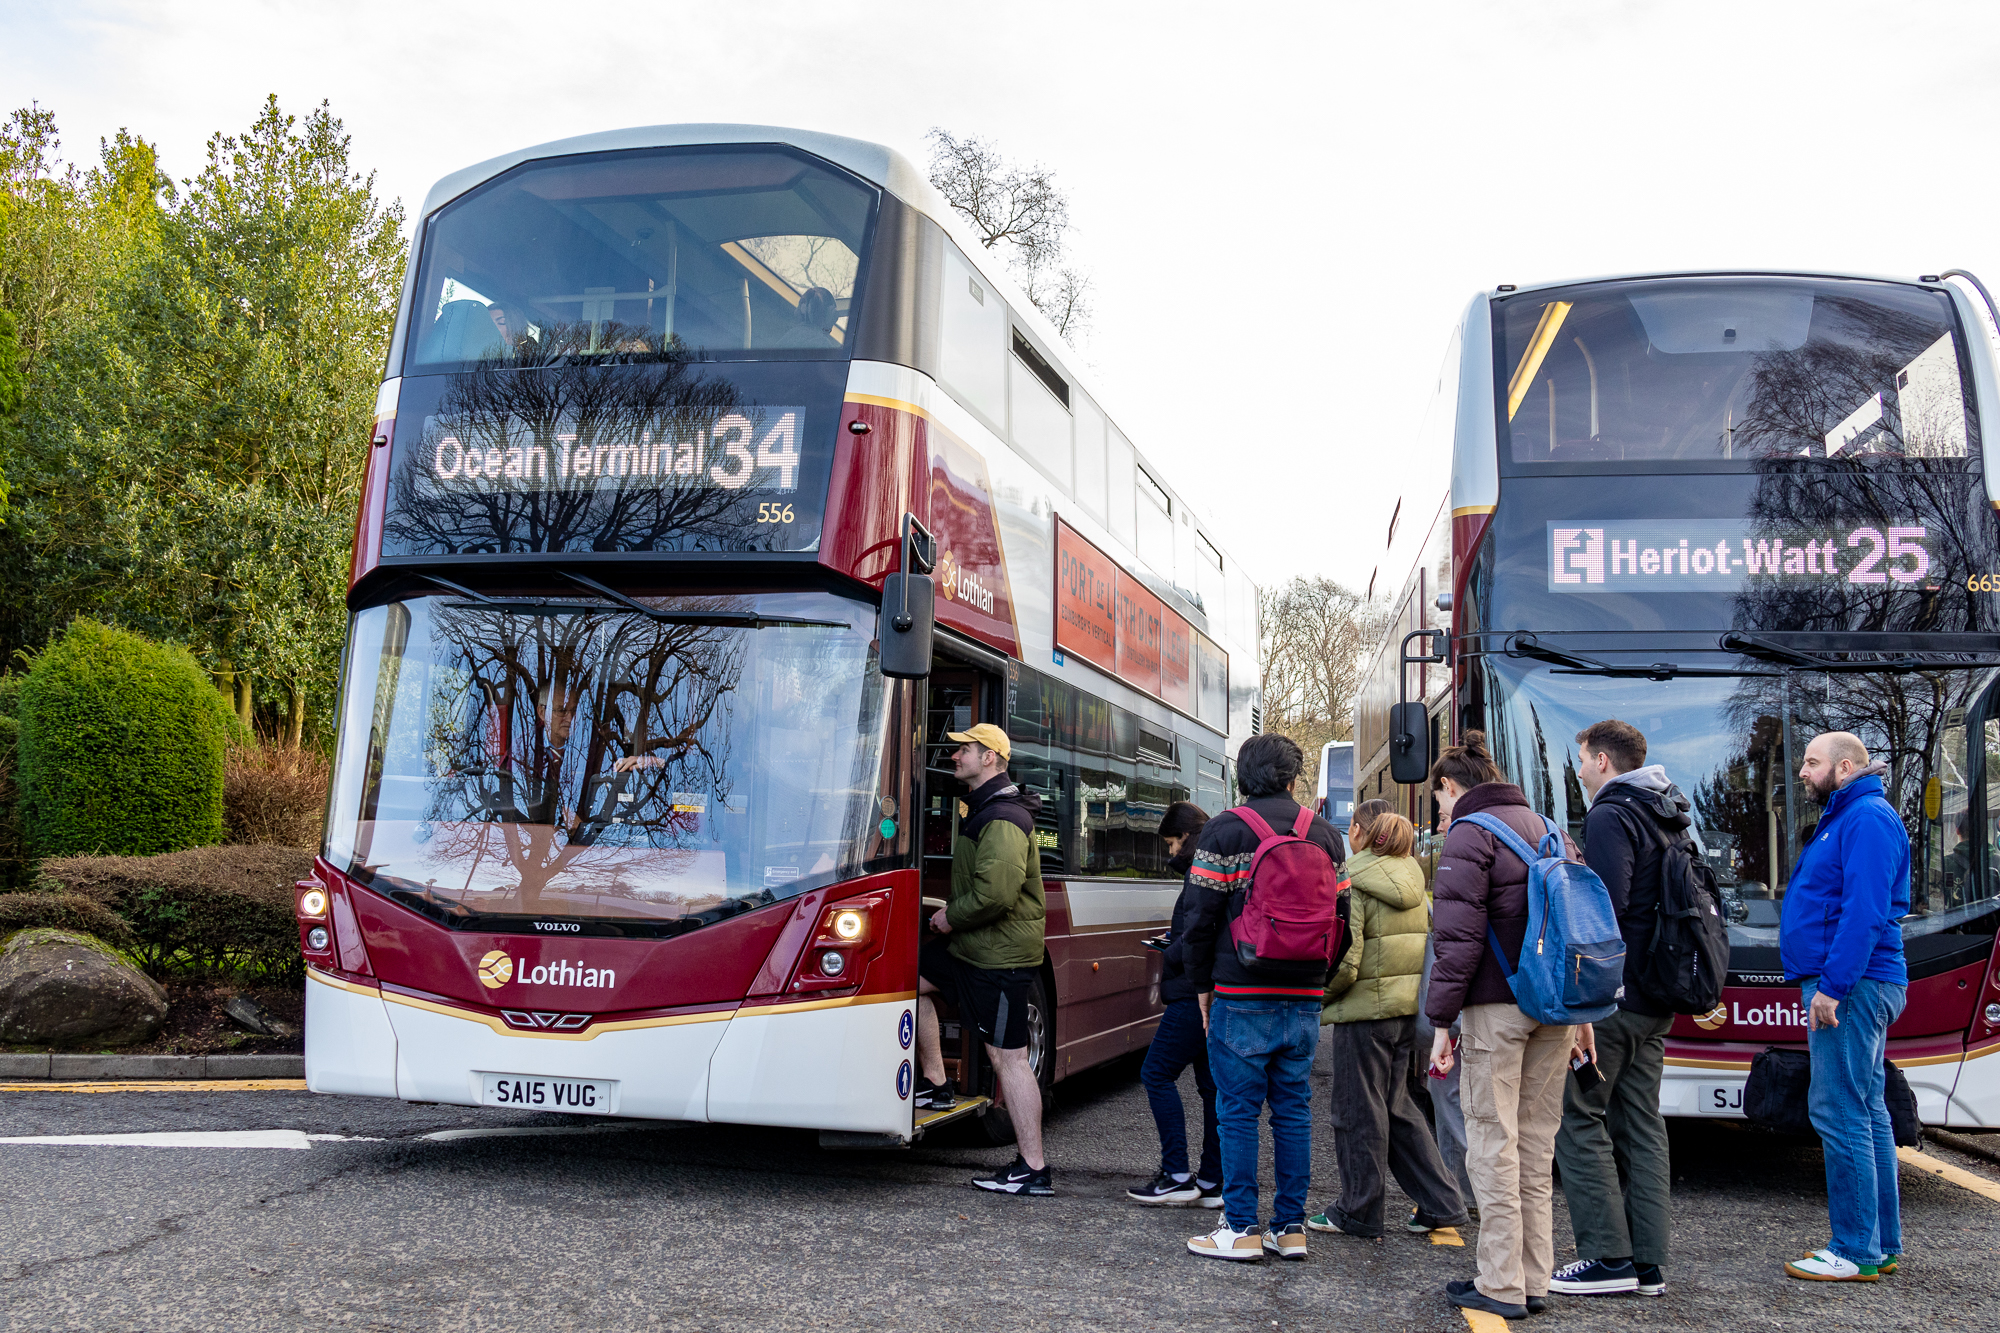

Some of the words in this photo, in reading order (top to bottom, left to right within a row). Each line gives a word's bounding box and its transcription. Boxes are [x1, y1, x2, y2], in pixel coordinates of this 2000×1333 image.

[435, 437, 547, 479] Ocean
[557, 431, 705, 477] Terminal
[710, 413, 798, 489] 34
[757, 503, 795, 524] 556
[1611, 539, 1838, 575] Heriot-Watt
[1847, 527, 1930, 583] 25
[957, 564, 994, 615] Lothian
[1062, 549, 1094, 607] PORT
[1096, 580, 1104, 604] OF
[1107, 582, 1135, 637] LEITH
[1967, 573, 2000, 592] 665
[1009, 661, 1018, 682] 556
[533, 921, 581, 932] VOLVO
[517, 957, 616, 989] Lothian
[1738, 974, 1786, 984] VOLVO
[1733, 1001, 1808, 1027] Lothia
[497, 1080, 546, 1105] SA15
[552, 1083, 596, 1107] VUG
[1713, 1088, 1742, 1108] SJ
